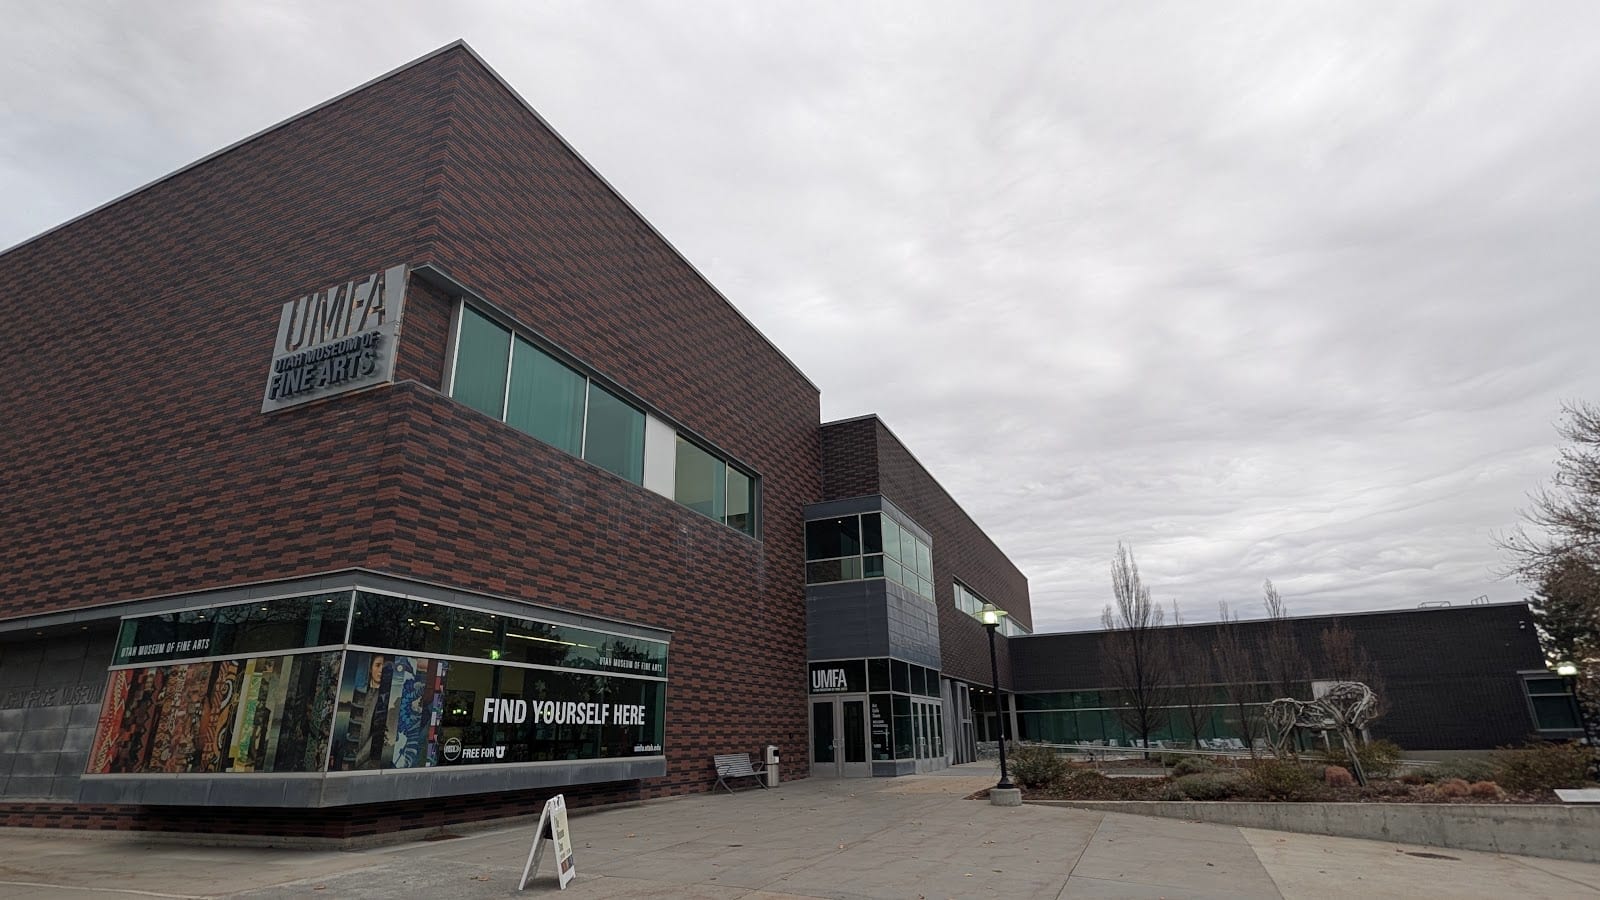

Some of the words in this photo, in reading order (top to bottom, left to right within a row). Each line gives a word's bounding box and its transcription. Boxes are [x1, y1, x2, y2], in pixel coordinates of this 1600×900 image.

[284, 271, 386, 352] UMFA
[274, 353, 306, 374] UTAH
[304, 335, 361, 365] MUSEUM
[361, 330, 382, 349] OF
[267, 364, 318, 401] FINE
[318, 349, 378, 387] ARTS
[121, 645, 138, 658] UTAH
[138, 643, 165, 656] MUSEUM
[166, 642, 175, 653] OF
[176, 640, 192, 652] FINE
[192, 638, 210, 650] ARTS
[613, 658, 633, 669] MUSEUM
[634, 660, 641, 670] OF
[641, 662, 651, 671] FINE
[652, 663, 662, 672] ARTS
[812, 669, 847, 688] UMFA
[483, 698, 527, 724] FIND
[533, 700, 610, 725] YOURSELF
[613, 704, 646, 725] HERE
[462, 748, 480, 759] FREE
[481, 747, 495, 758] FOR
[496, 745, 506, 759] U
